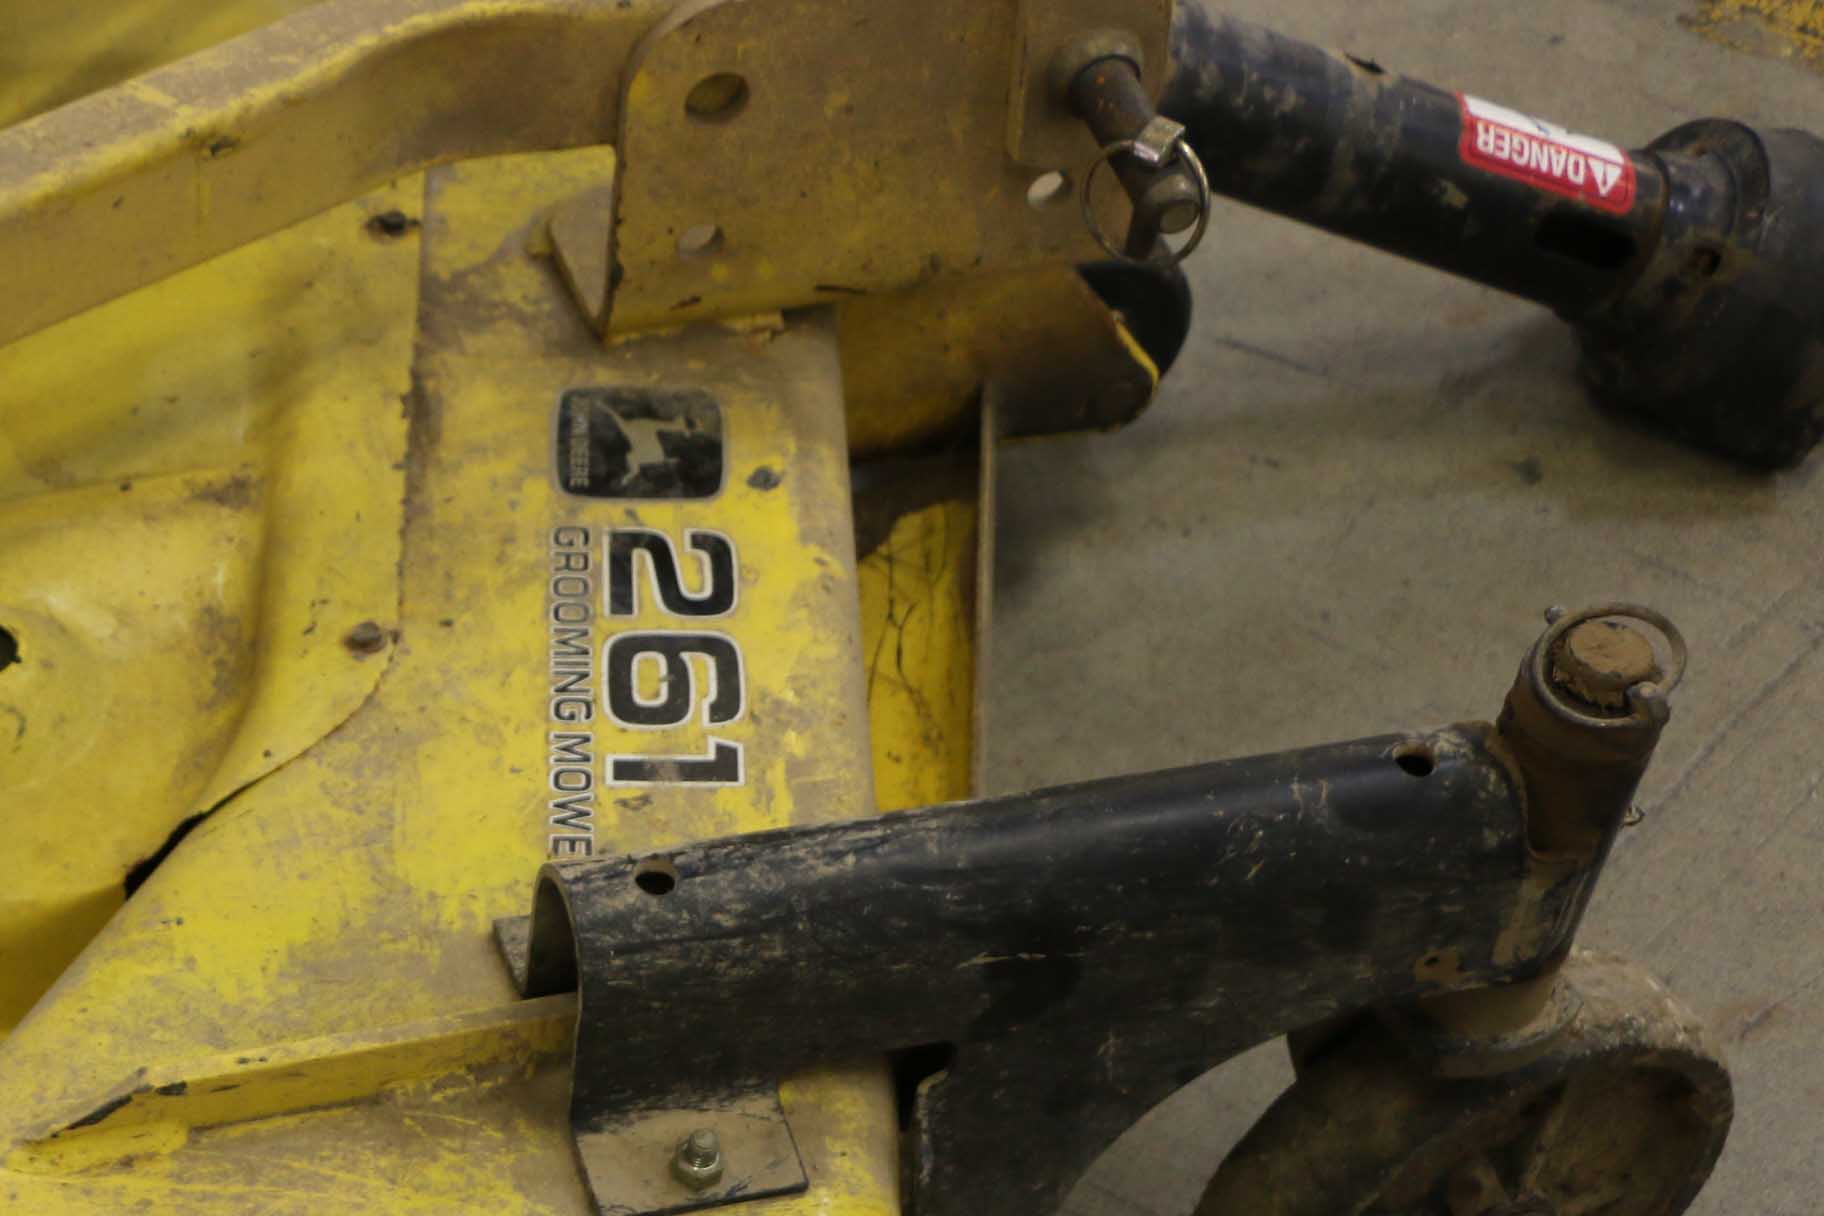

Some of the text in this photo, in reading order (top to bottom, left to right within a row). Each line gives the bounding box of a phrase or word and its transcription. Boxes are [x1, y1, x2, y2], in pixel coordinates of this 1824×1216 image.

[1476, 121, 1586, 184] DANGER
[550, 525, 592, 722] GROOMING
[603, 527, 744, 786] 261
